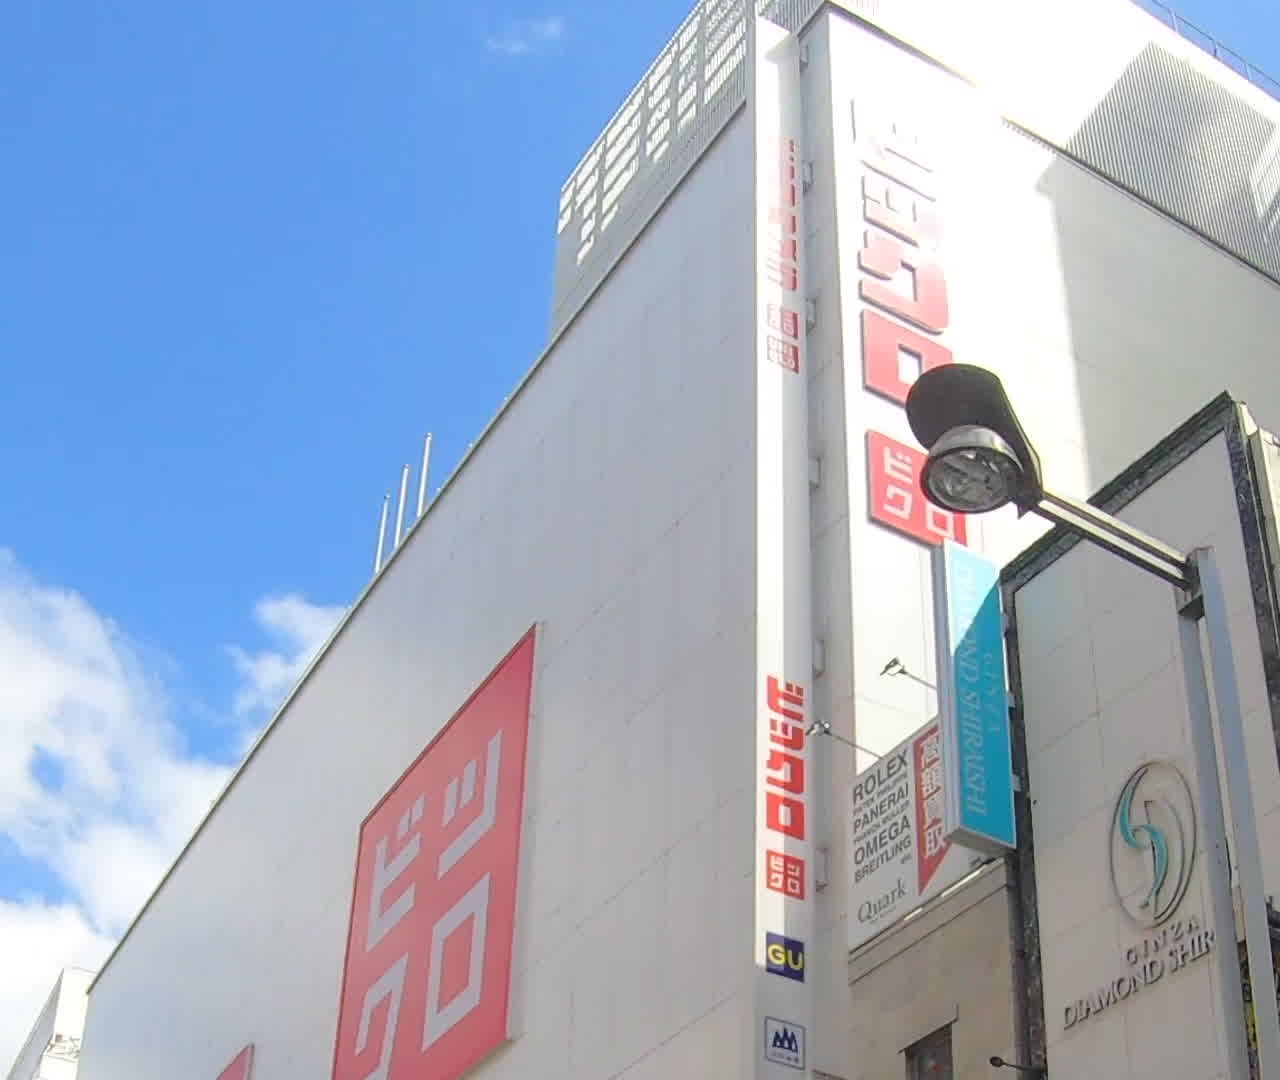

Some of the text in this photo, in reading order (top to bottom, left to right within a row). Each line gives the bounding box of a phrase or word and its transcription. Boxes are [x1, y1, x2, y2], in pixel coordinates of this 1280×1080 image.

[852, 747, 909, 804] ROLEX
[852, 781, 910, 835] PANERAI
[853, 814, 912, 866] OMEGA
[853, 834, 913, 885] BREITLING
[767, 941, 804, 973] GU
[1063, 957, 1166, 1031] DIAMOND
